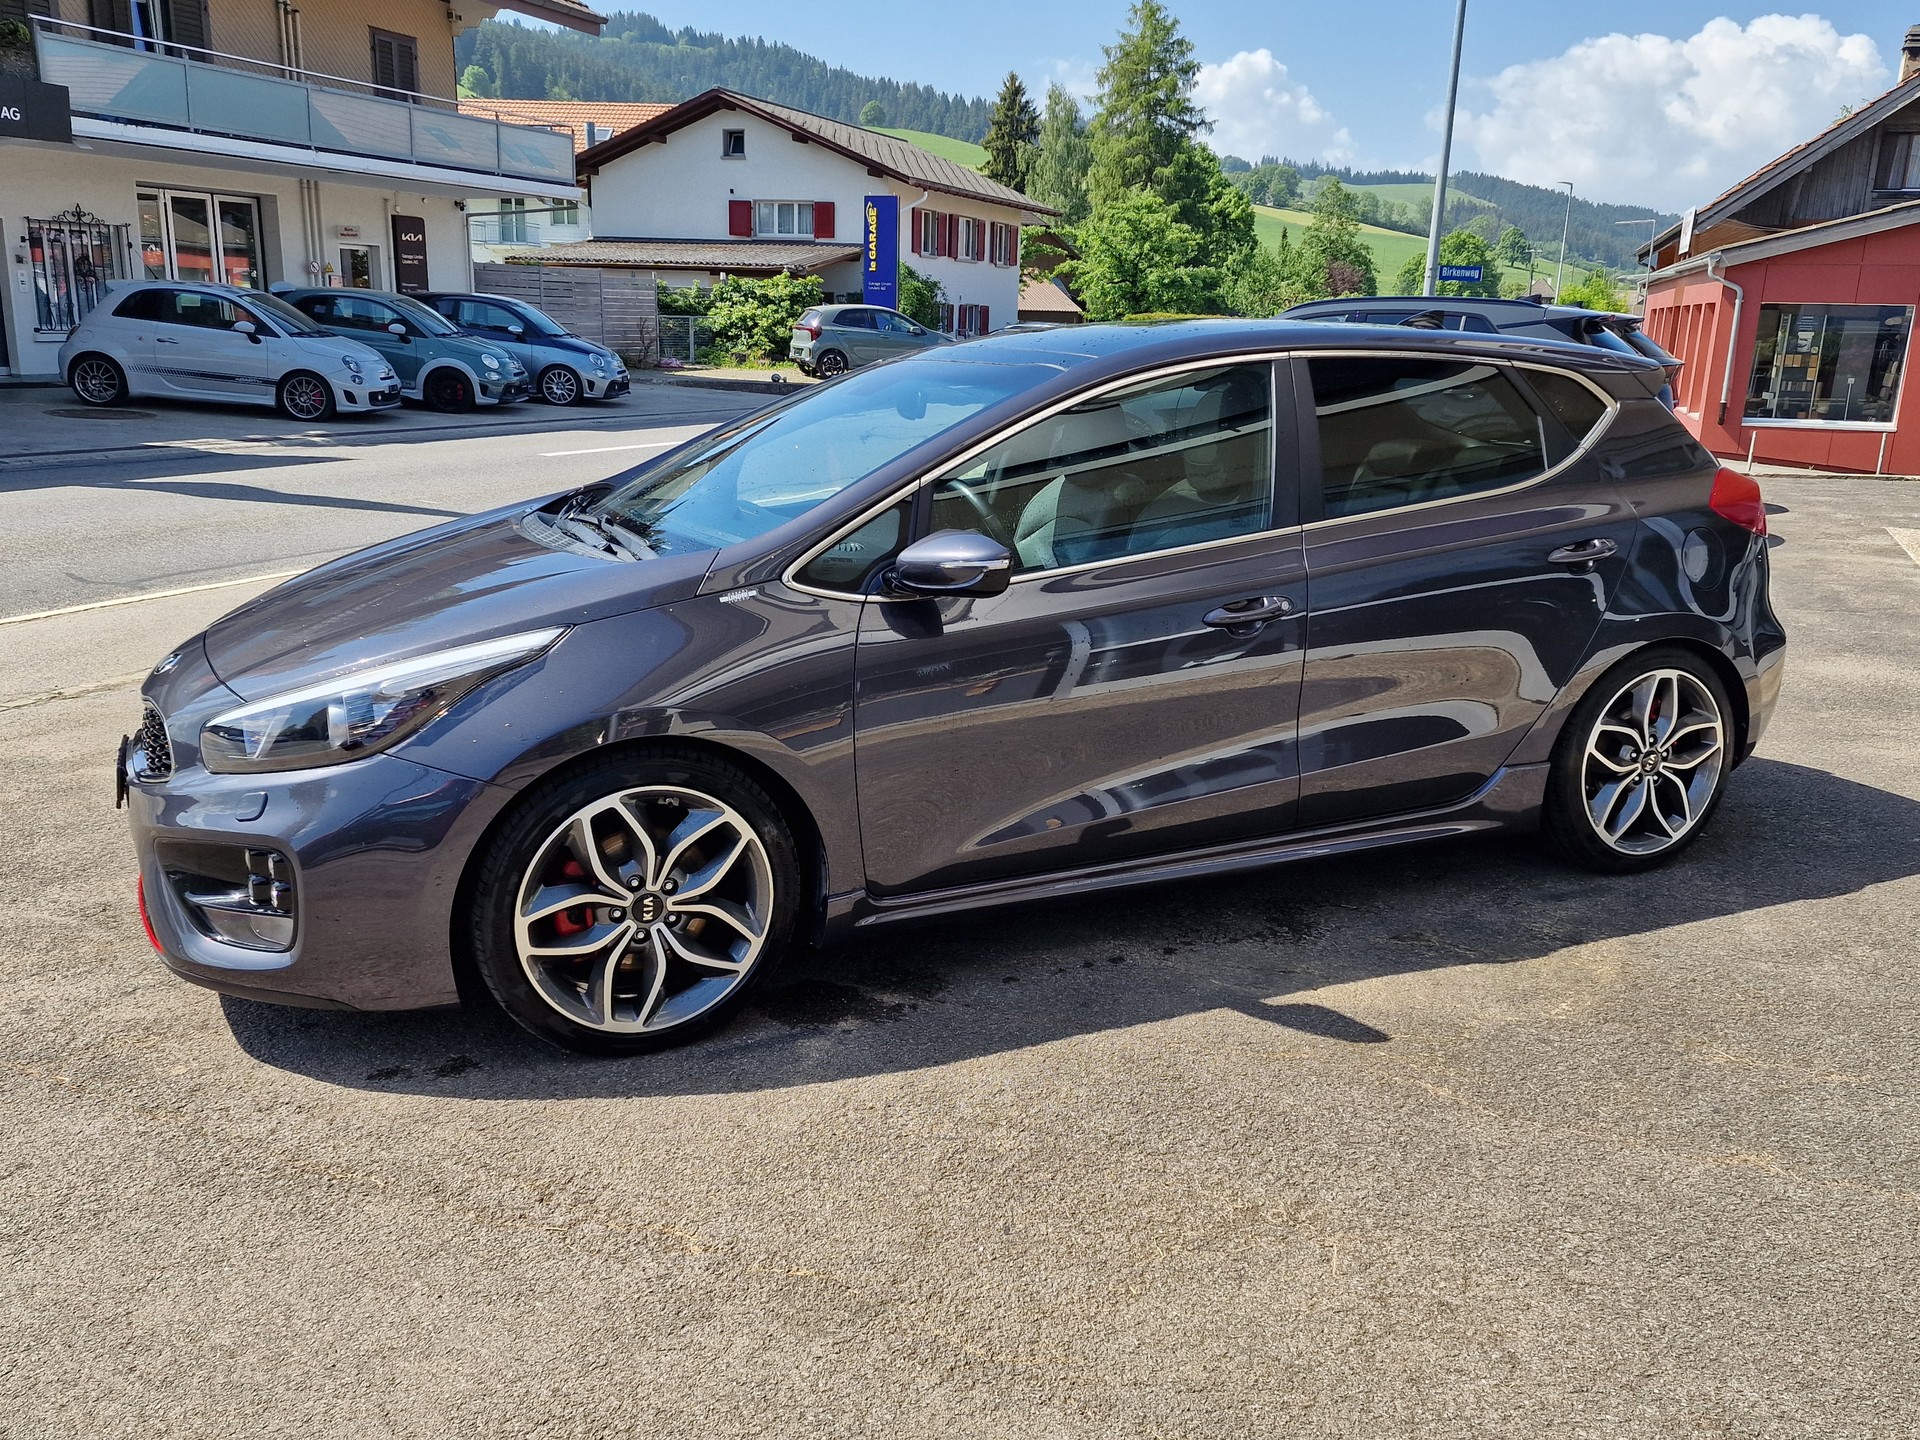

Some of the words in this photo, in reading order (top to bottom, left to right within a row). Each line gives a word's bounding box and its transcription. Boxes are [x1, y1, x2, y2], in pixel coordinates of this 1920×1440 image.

[1, 106, 21, 121] AG
[402, 233, 422, 241] KIA
[869, 207, 877, 260] GARAGE
[869, 261, 876, 272] le
[1442, 267, 1480, 279] Birkenweg
[1645, 754, 1657, 771] KIA
[643, 896, 653, 921] KIA
